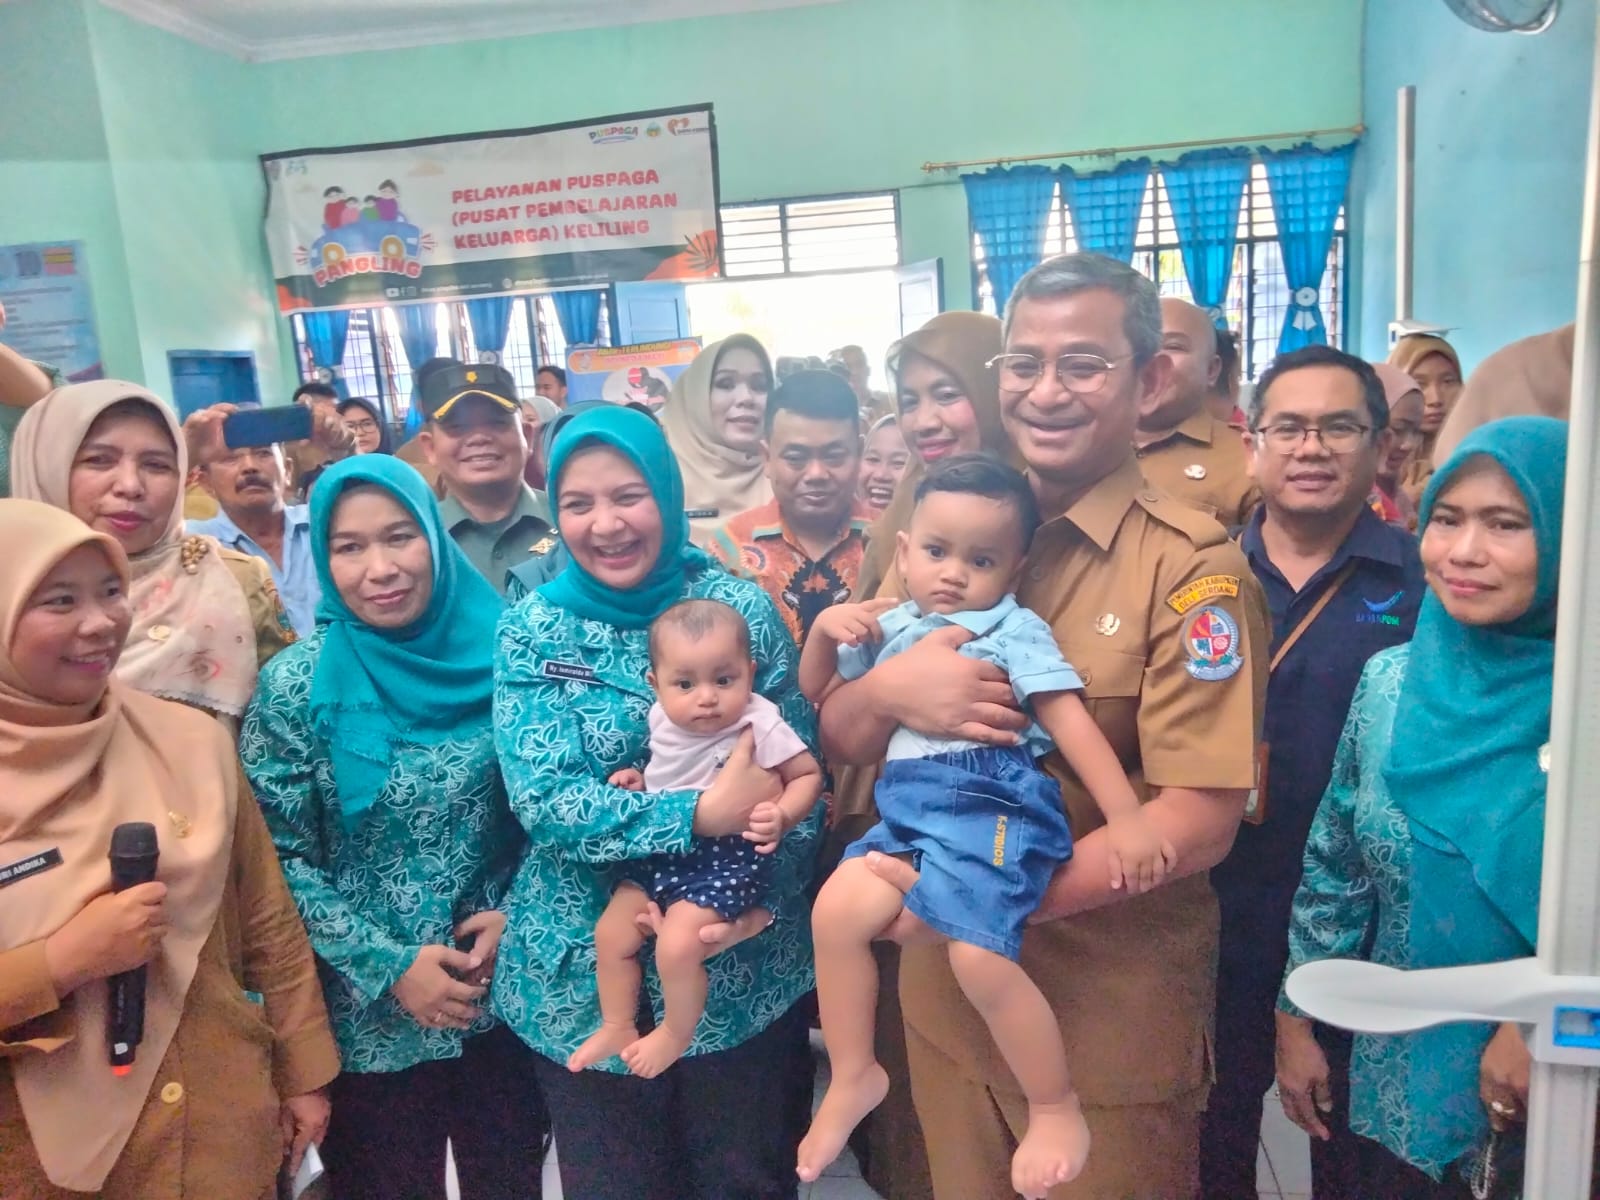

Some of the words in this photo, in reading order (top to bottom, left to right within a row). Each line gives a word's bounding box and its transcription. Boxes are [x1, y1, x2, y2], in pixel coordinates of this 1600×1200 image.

[452, 178, 562, 204] PELAYANAN
[567, 169, 659, 190] PUSPAGA
[452, 205, 521, 227] (PUSAT
[526, 193, 678, 219] PEMBELAJARAN
[454, 226, 559, 250] KELUARGA)
[564, 219, 650, 240] KELILING
[314, 255, 421, 287] PANGLING
[13, 857, 47, 875] ANDIKA
